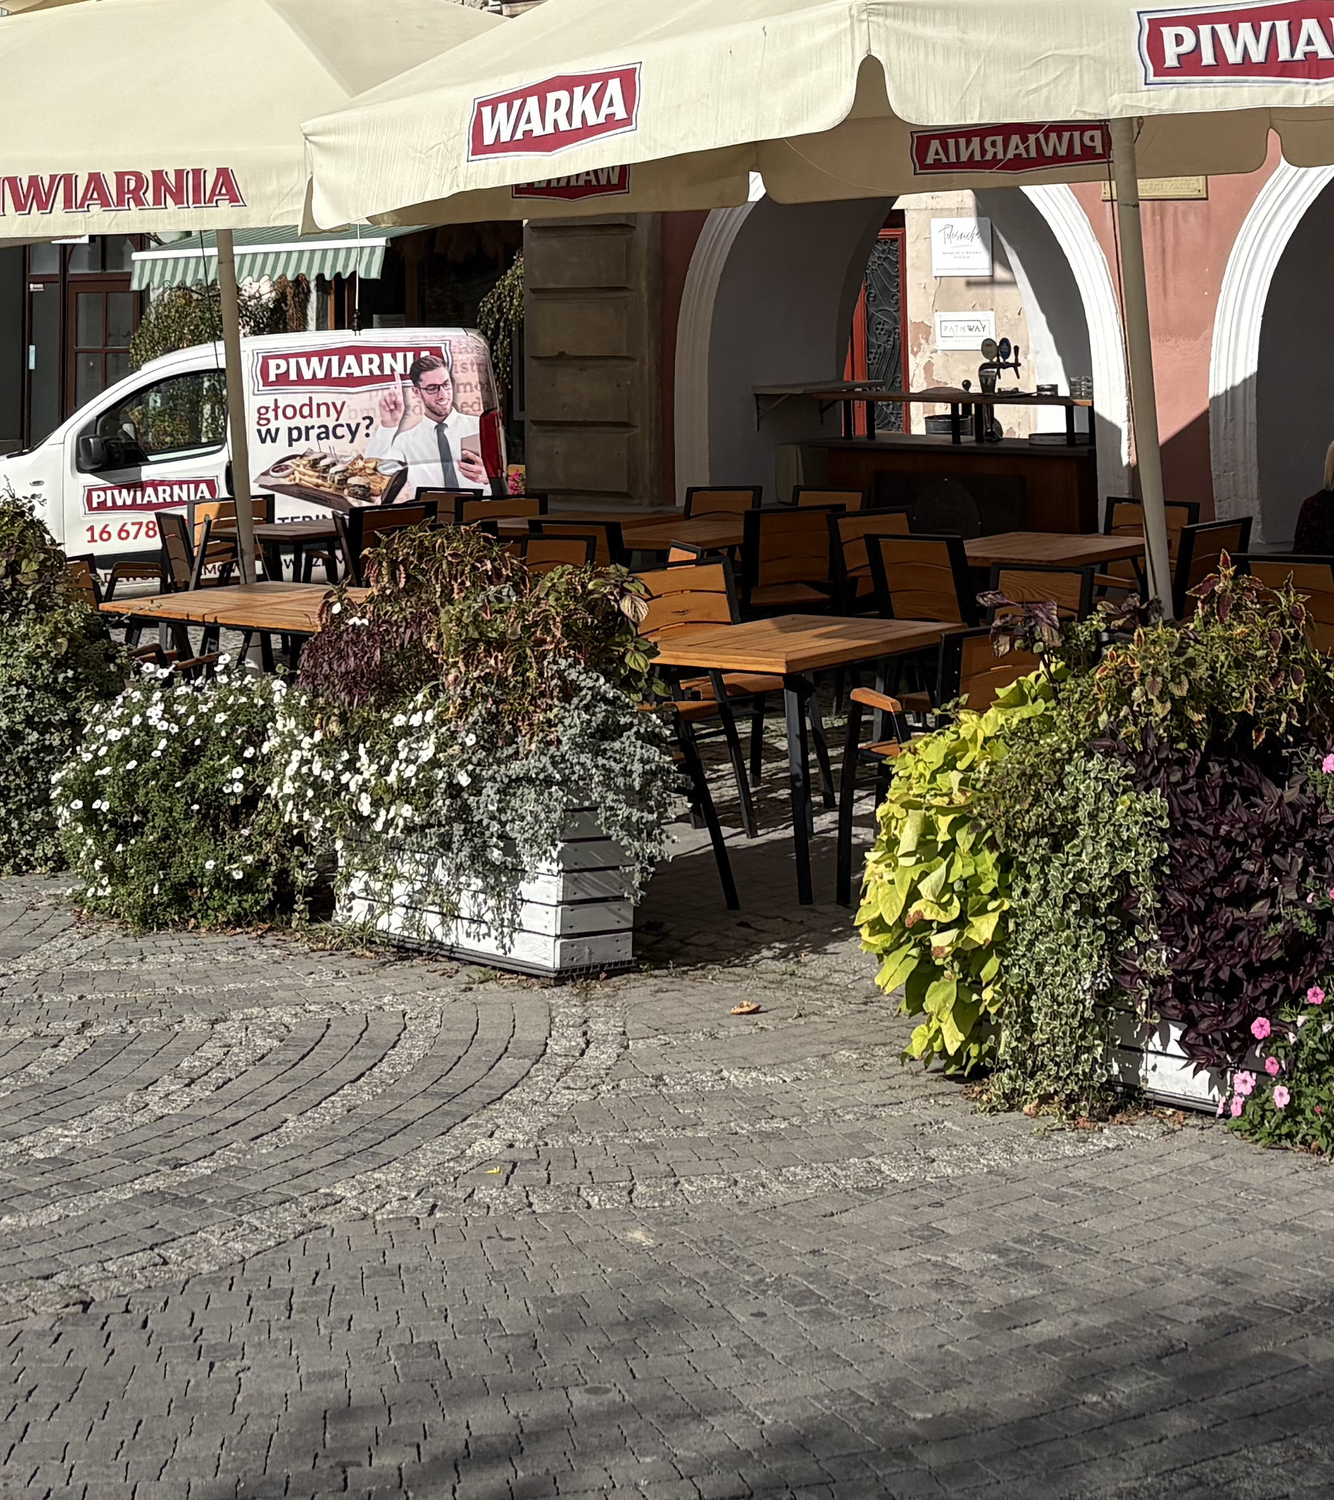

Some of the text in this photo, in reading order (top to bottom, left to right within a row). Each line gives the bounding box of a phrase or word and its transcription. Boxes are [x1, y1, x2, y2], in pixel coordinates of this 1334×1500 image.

[480, 77, 629, 145] WARKA
[256, 397, 347, 428] głodny
[256, 416, 374, 447] w pracy?
[91, 482, 212, 508] PIWIARNIA
[86, 521, 158, 544] 16 678
